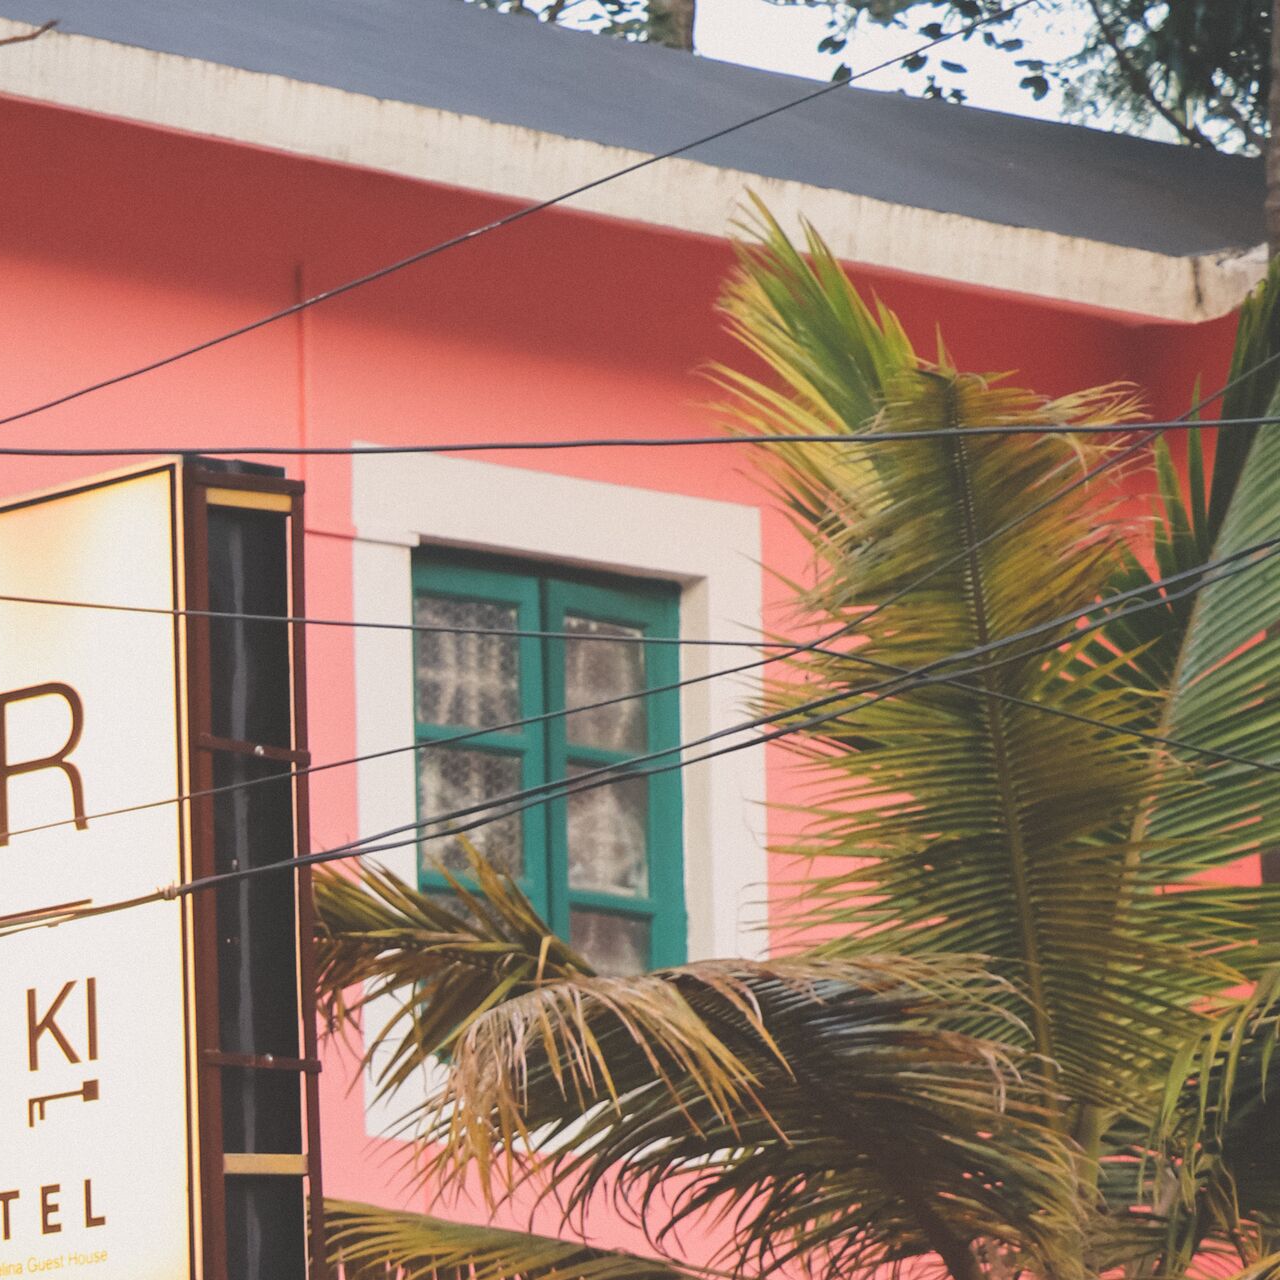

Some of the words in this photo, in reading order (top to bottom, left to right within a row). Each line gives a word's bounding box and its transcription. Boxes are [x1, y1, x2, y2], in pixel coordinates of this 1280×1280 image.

[26, 976, 99, 1072] KI
[27, 1255, 64, 1274] Guest
[67, 1249, 109, 1266] House
